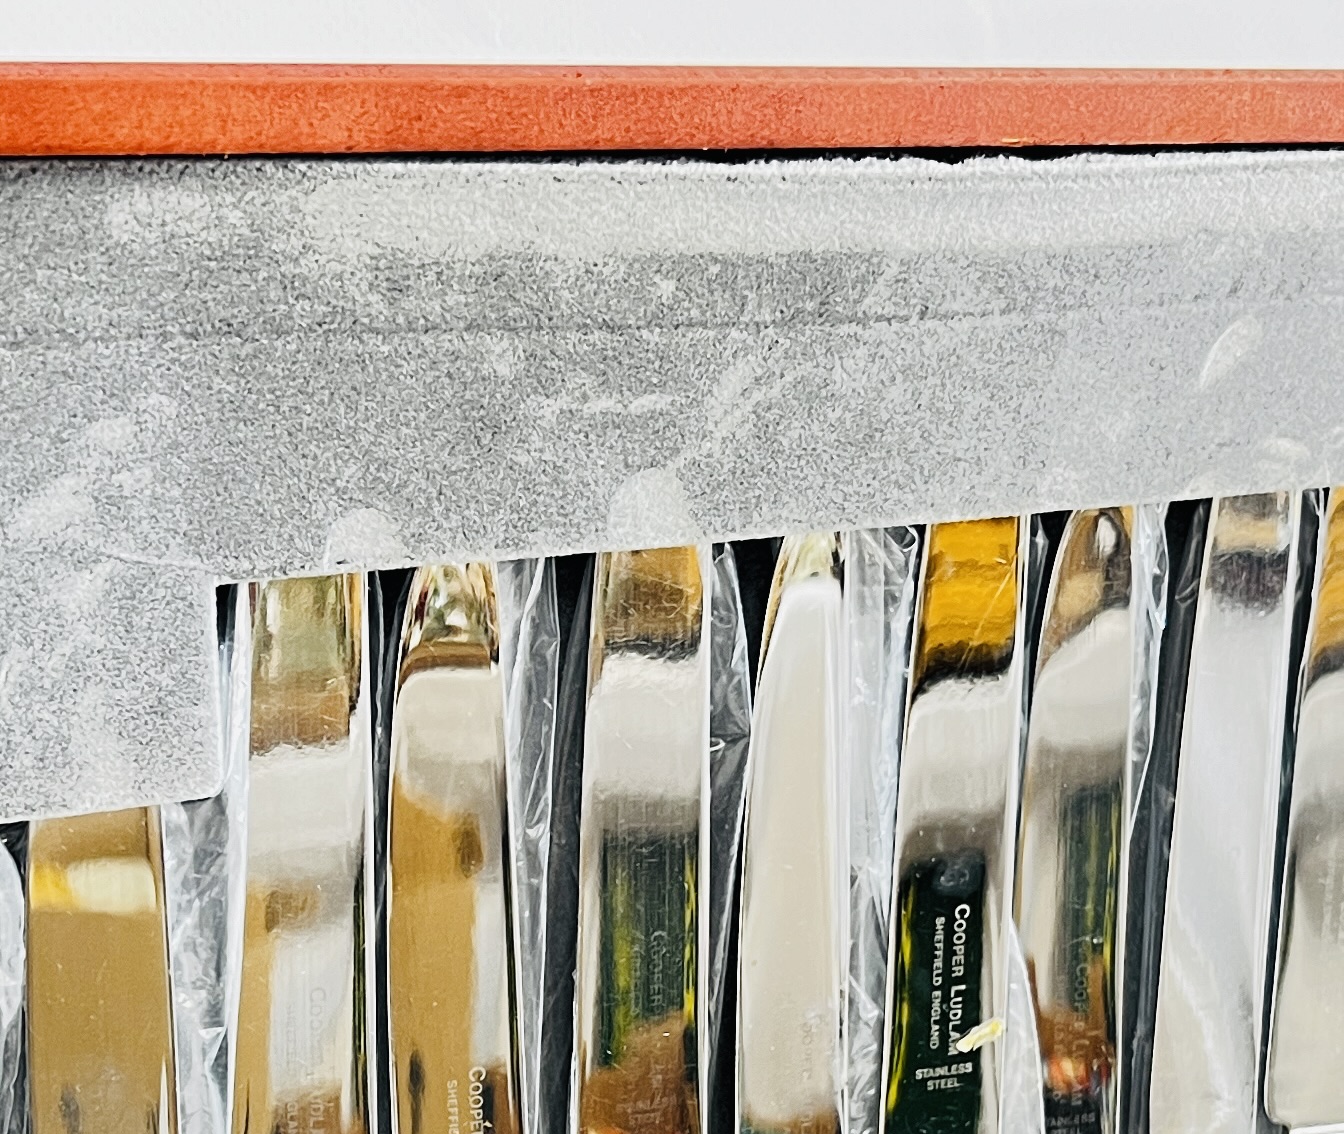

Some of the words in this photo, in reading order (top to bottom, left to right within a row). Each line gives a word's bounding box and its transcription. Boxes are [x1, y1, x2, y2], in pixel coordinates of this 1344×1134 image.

[932, 916, 946, 986] SHEFFIELD
[951, 903, 971, 978] COOPER
[929, 990, 942, 1050] ENGLAND
[947, 984, 967, 1056] LUDLAM
[915, 1061, 973, 1080] STAINLESS
[926, 1077, 961, 1091] STEEL
